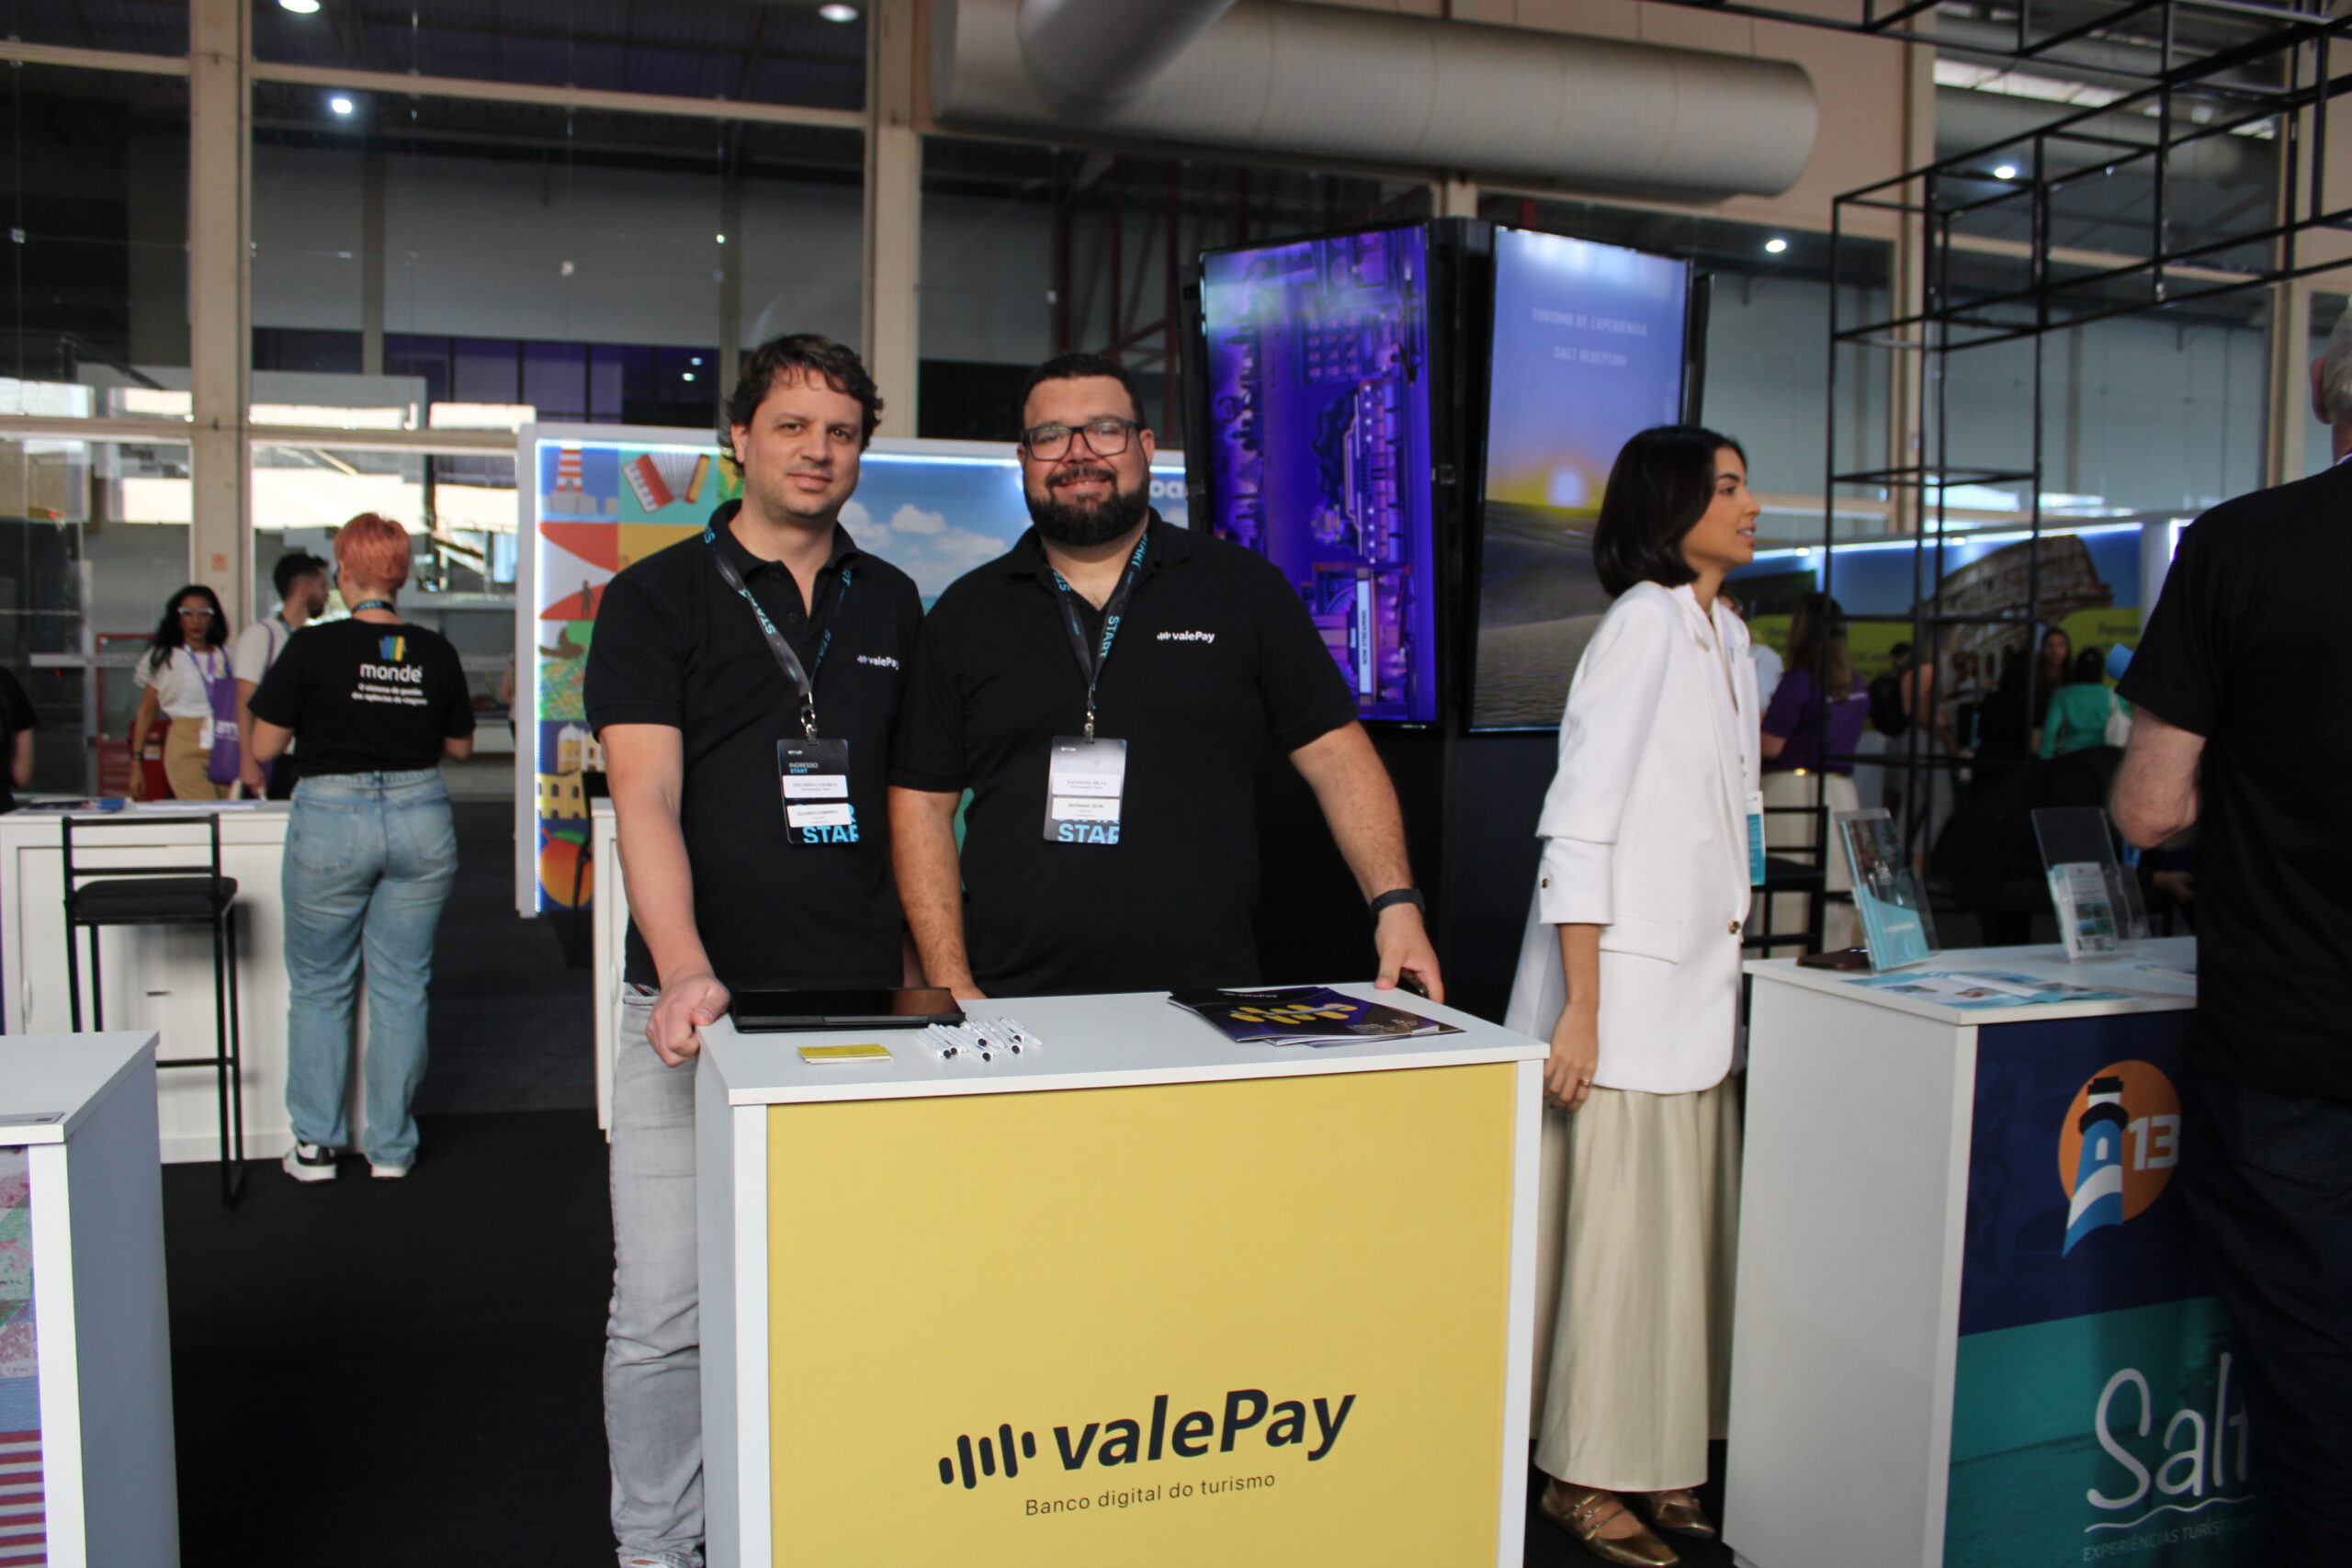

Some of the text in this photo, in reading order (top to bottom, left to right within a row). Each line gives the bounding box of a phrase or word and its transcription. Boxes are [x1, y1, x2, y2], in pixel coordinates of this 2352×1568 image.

[1099, 615, 1121, 658] START
[1171, 630, 1216, 644] valePay
[359, 663, 423, 683] monde
[2127, 1114, 2182, 1171] 13
[1052, 1388, 1357, 1471] valePay
[2086, 1351, 2249, 1509] Salt
[1025, 1473, 1276, 1517] Banco digital do turismo
[2083, 1528, 2179, 1562] EXPERIÊNCIAS
